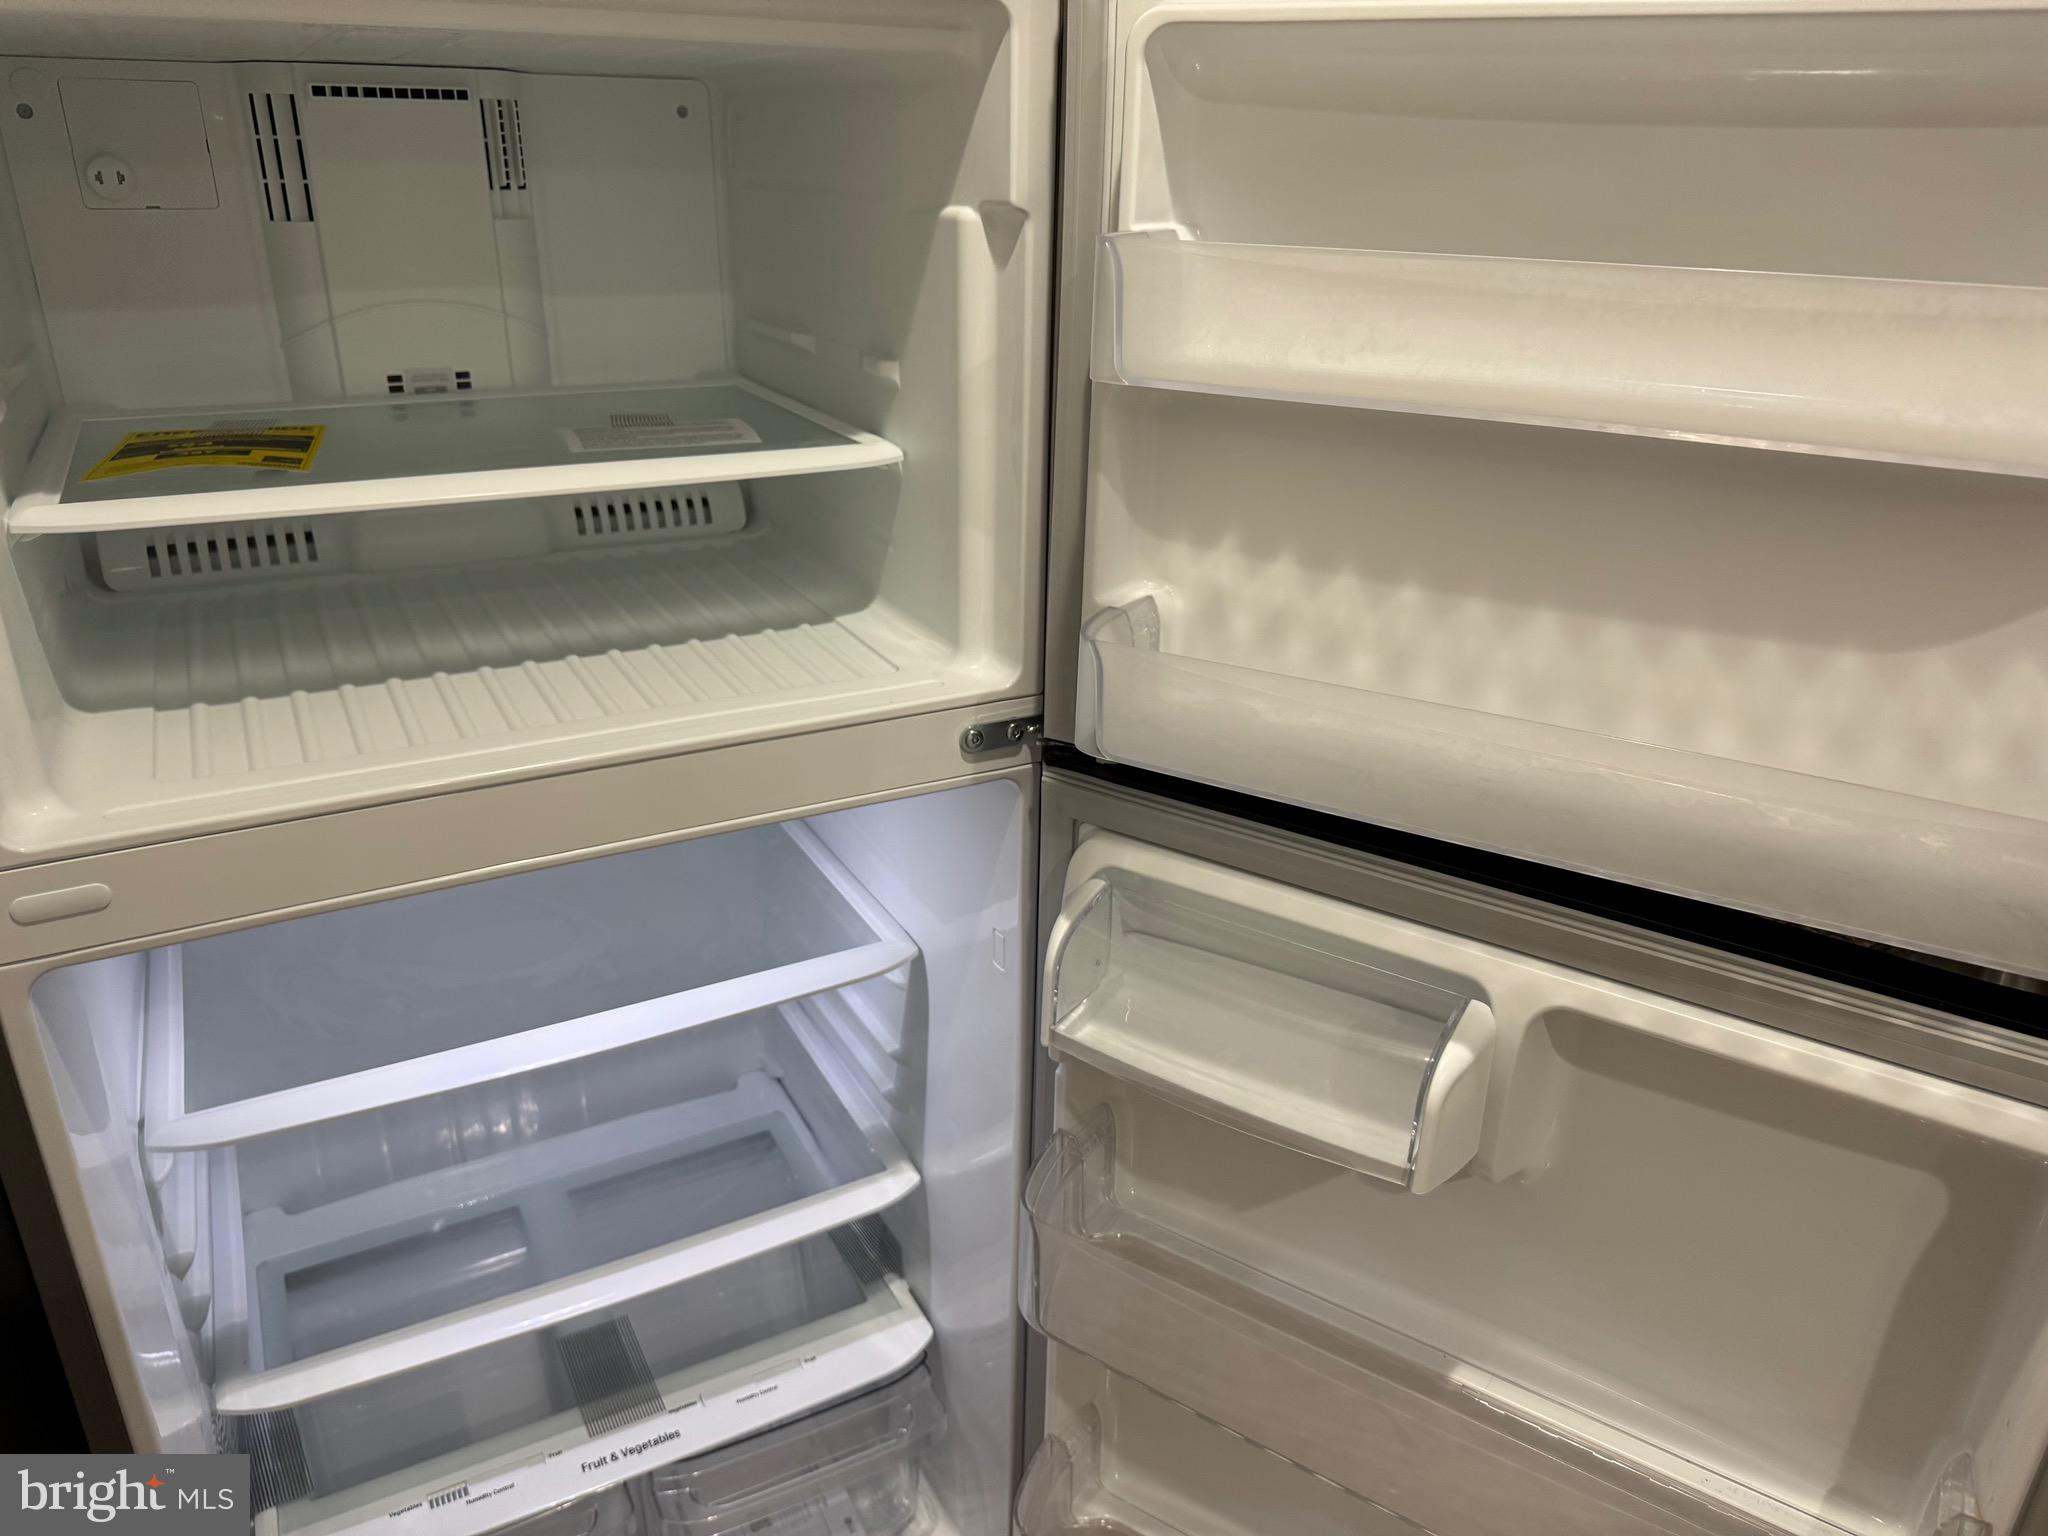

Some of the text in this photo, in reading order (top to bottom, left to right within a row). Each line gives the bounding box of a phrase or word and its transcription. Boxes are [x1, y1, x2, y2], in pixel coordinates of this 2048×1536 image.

[581, 1429, 682, 1473] Fruit & Vegetables
[465, 1482, 516, 1506] Humidity Control
[389, 1502, 423, 1517] Vegetables
